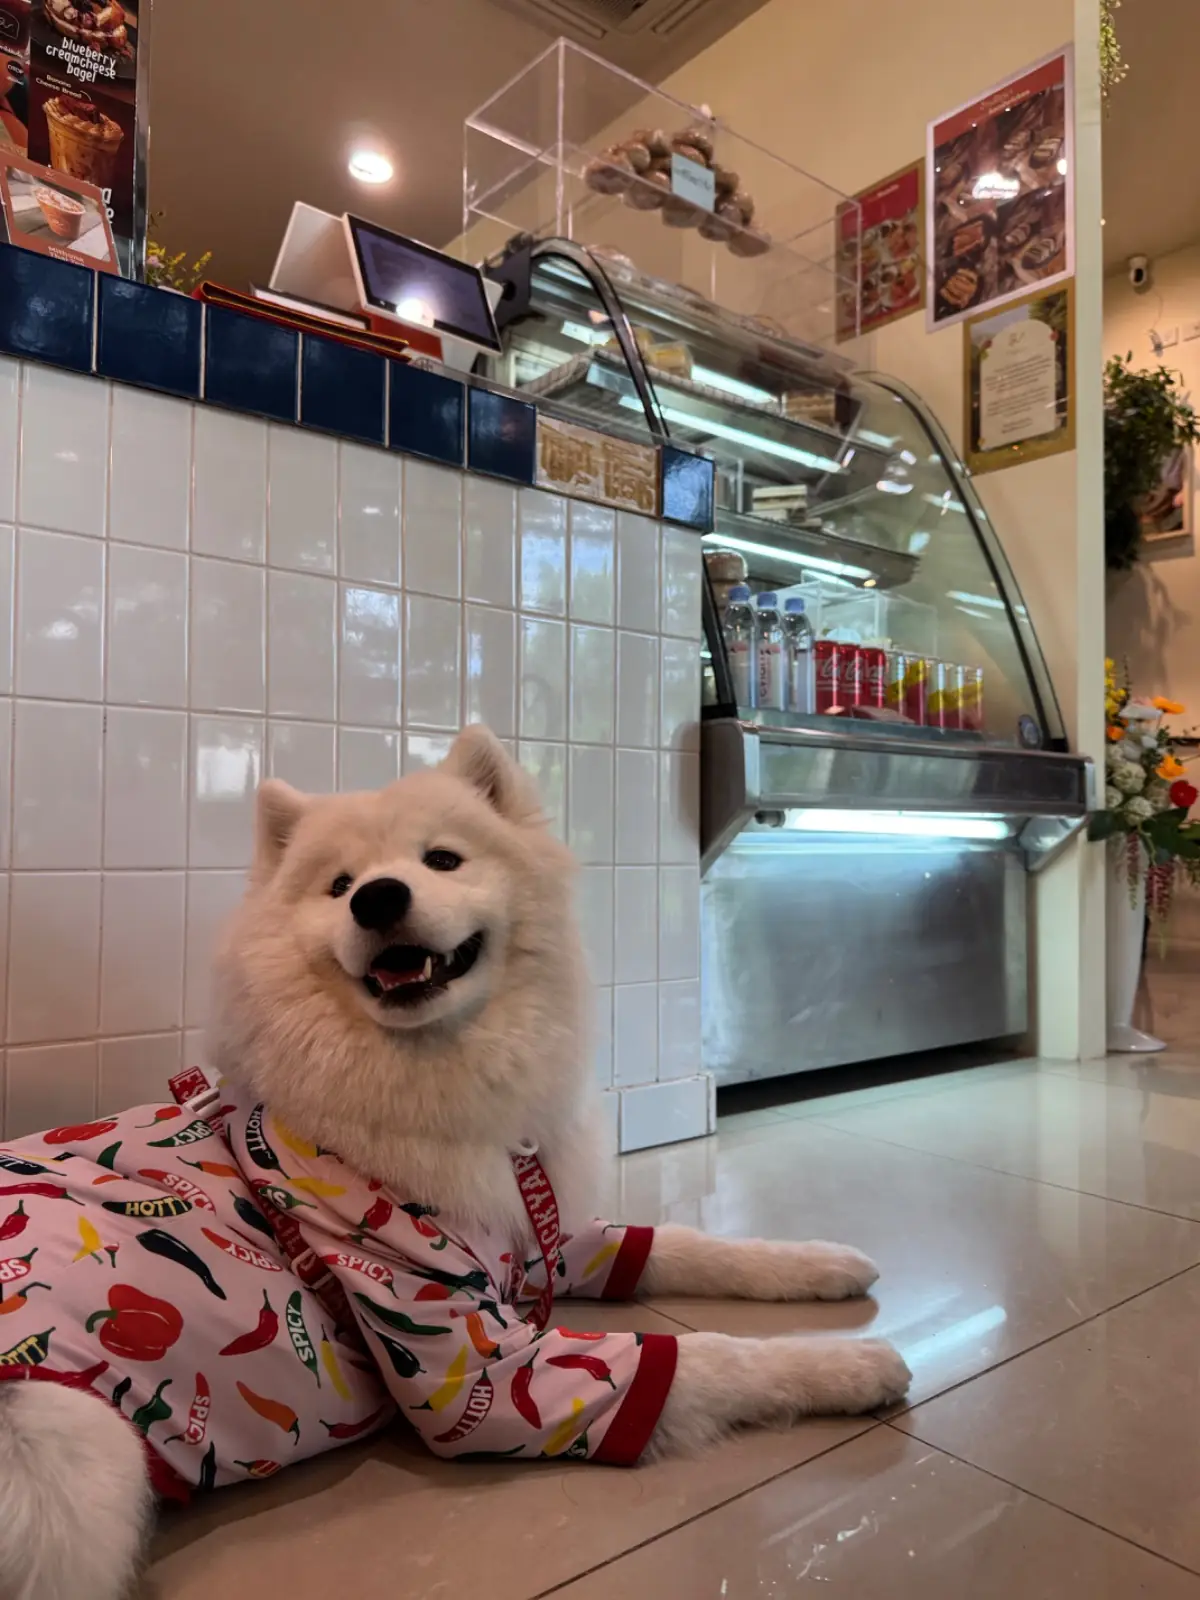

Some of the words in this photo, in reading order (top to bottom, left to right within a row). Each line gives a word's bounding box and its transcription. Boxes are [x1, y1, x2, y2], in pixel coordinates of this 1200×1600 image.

[46, 45, 116, 79] creamcheese
[62, 37, 116, 69] blueberry
[67, 62, 96, 83] bagel
[337, 1254, 392, 1284] SPICY
[288, 1303, 313, 1362] SPICY
